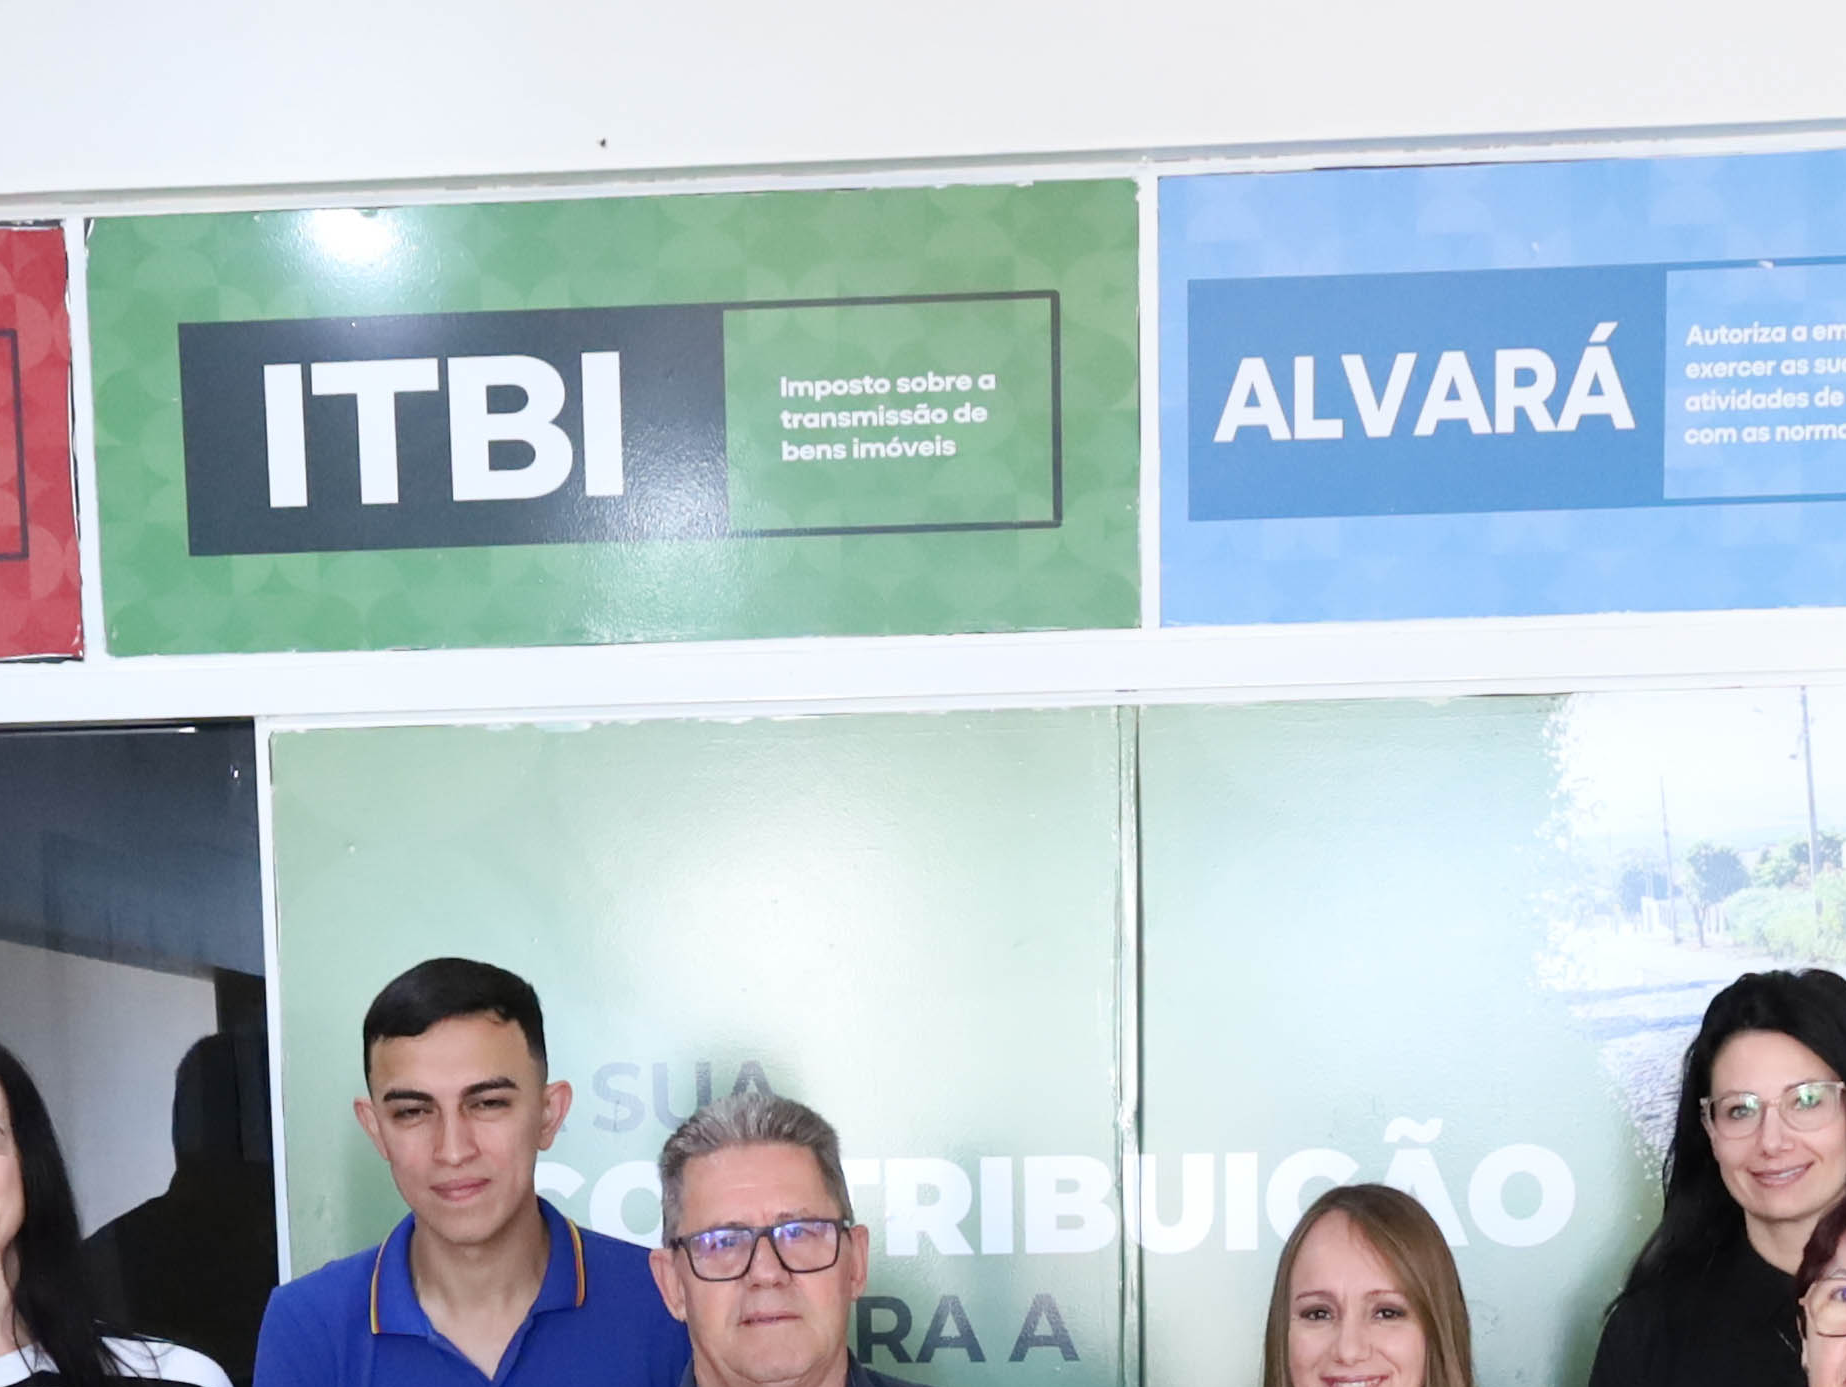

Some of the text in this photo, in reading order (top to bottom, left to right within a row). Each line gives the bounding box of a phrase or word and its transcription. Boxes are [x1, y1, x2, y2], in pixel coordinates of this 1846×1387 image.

[1686, 321, 1786, 346] Autoriza
[1791, 325, 1807, 342] a
[1685, 360, 1776, 379] exercer
[1780, 357, 1809, 376] as
[780, 371, 996, 401] Imposto sobre a
[1214, 322, 1635, 443] ALVARÁ
[1684, 387, 1809, 413] atividades
[1814, 385, 1844, 407] de
[264, 350, 624, 508] ITBI
[780, 402, 988, 429] transmissão de
[781, 435, 956, 461] bens imóveis
[1684, 427, 1737, 445] com
[1742, 425, 1770, 442] as
[856, 1292, 1081, 1364] RA A
